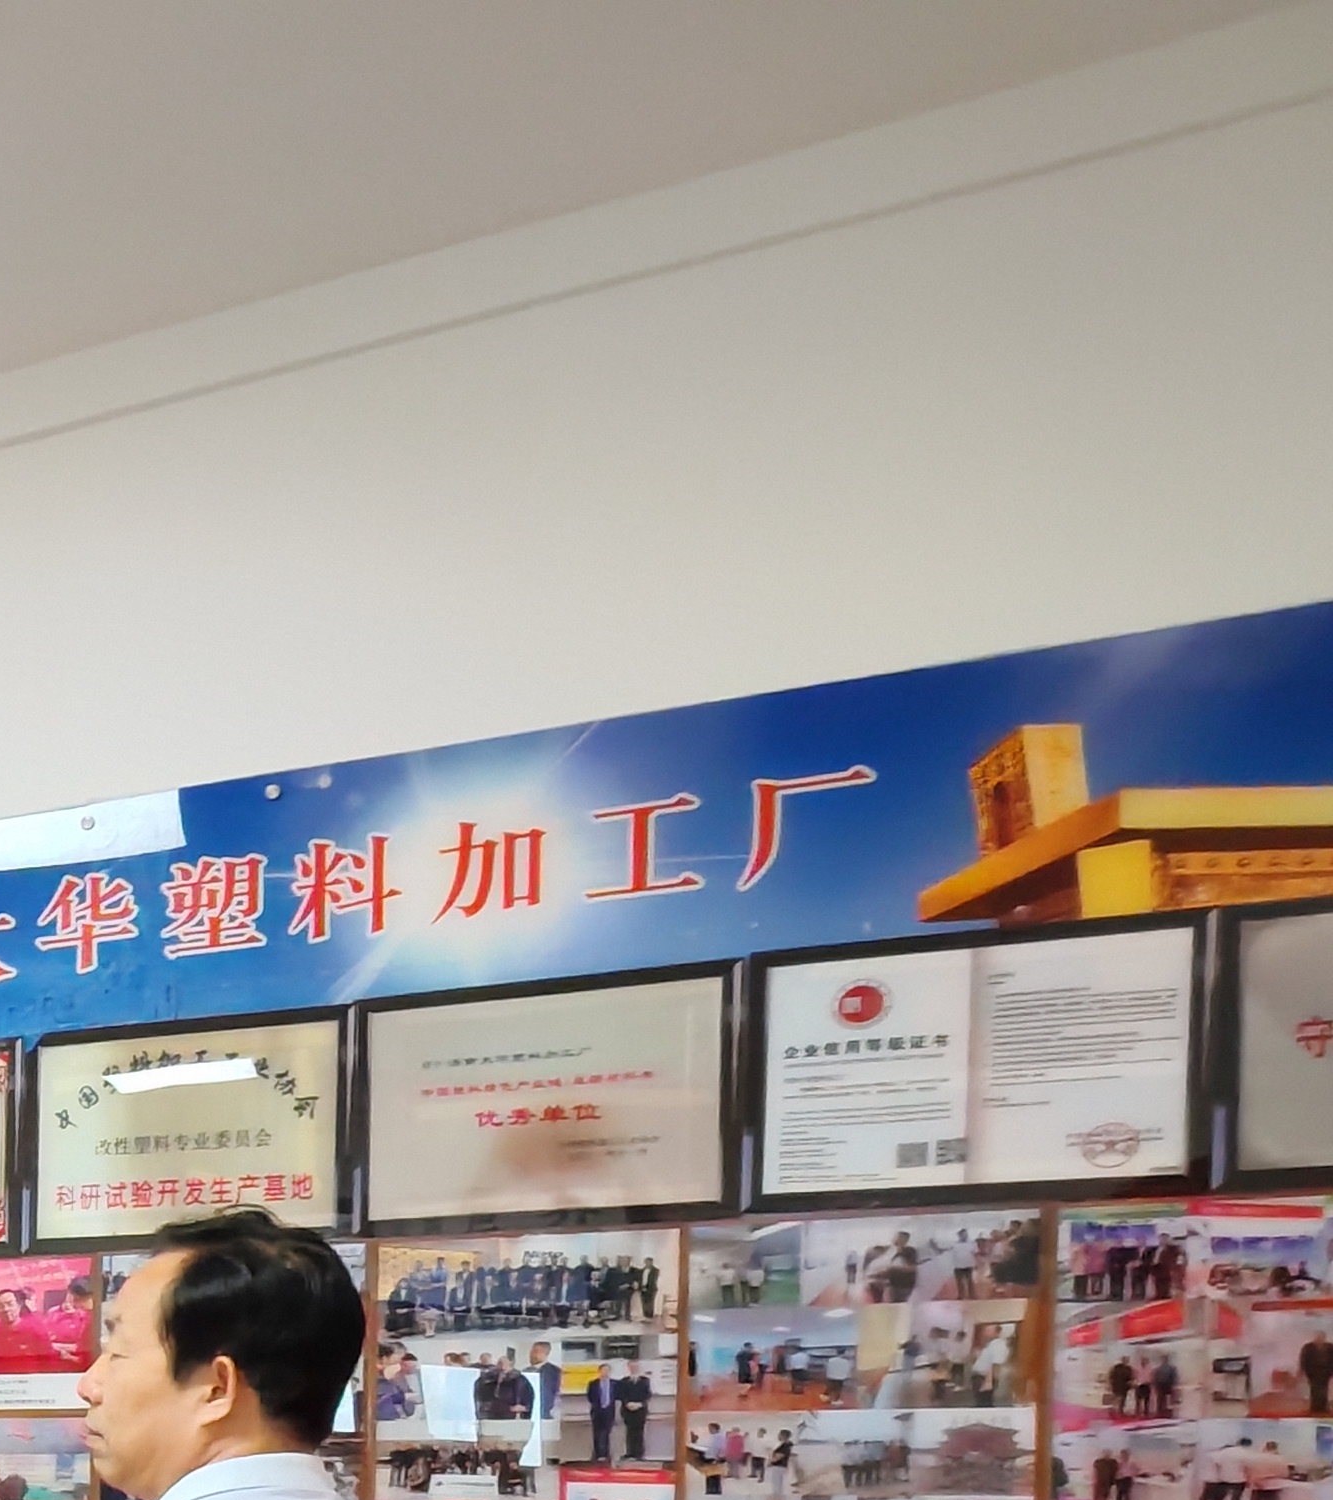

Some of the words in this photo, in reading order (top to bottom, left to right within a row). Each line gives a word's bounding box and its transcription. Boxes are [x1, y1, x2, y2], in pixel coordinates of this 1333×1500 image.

[783, 1034, 950, 1060] 企业信用等级证书
[475, 1103, 602, 1128] 优秀单位
[95, 1128, 273, 1156] 改性塑料专业委员会
[55, 1172, 315, 1211] 科研试验开发生产基地
